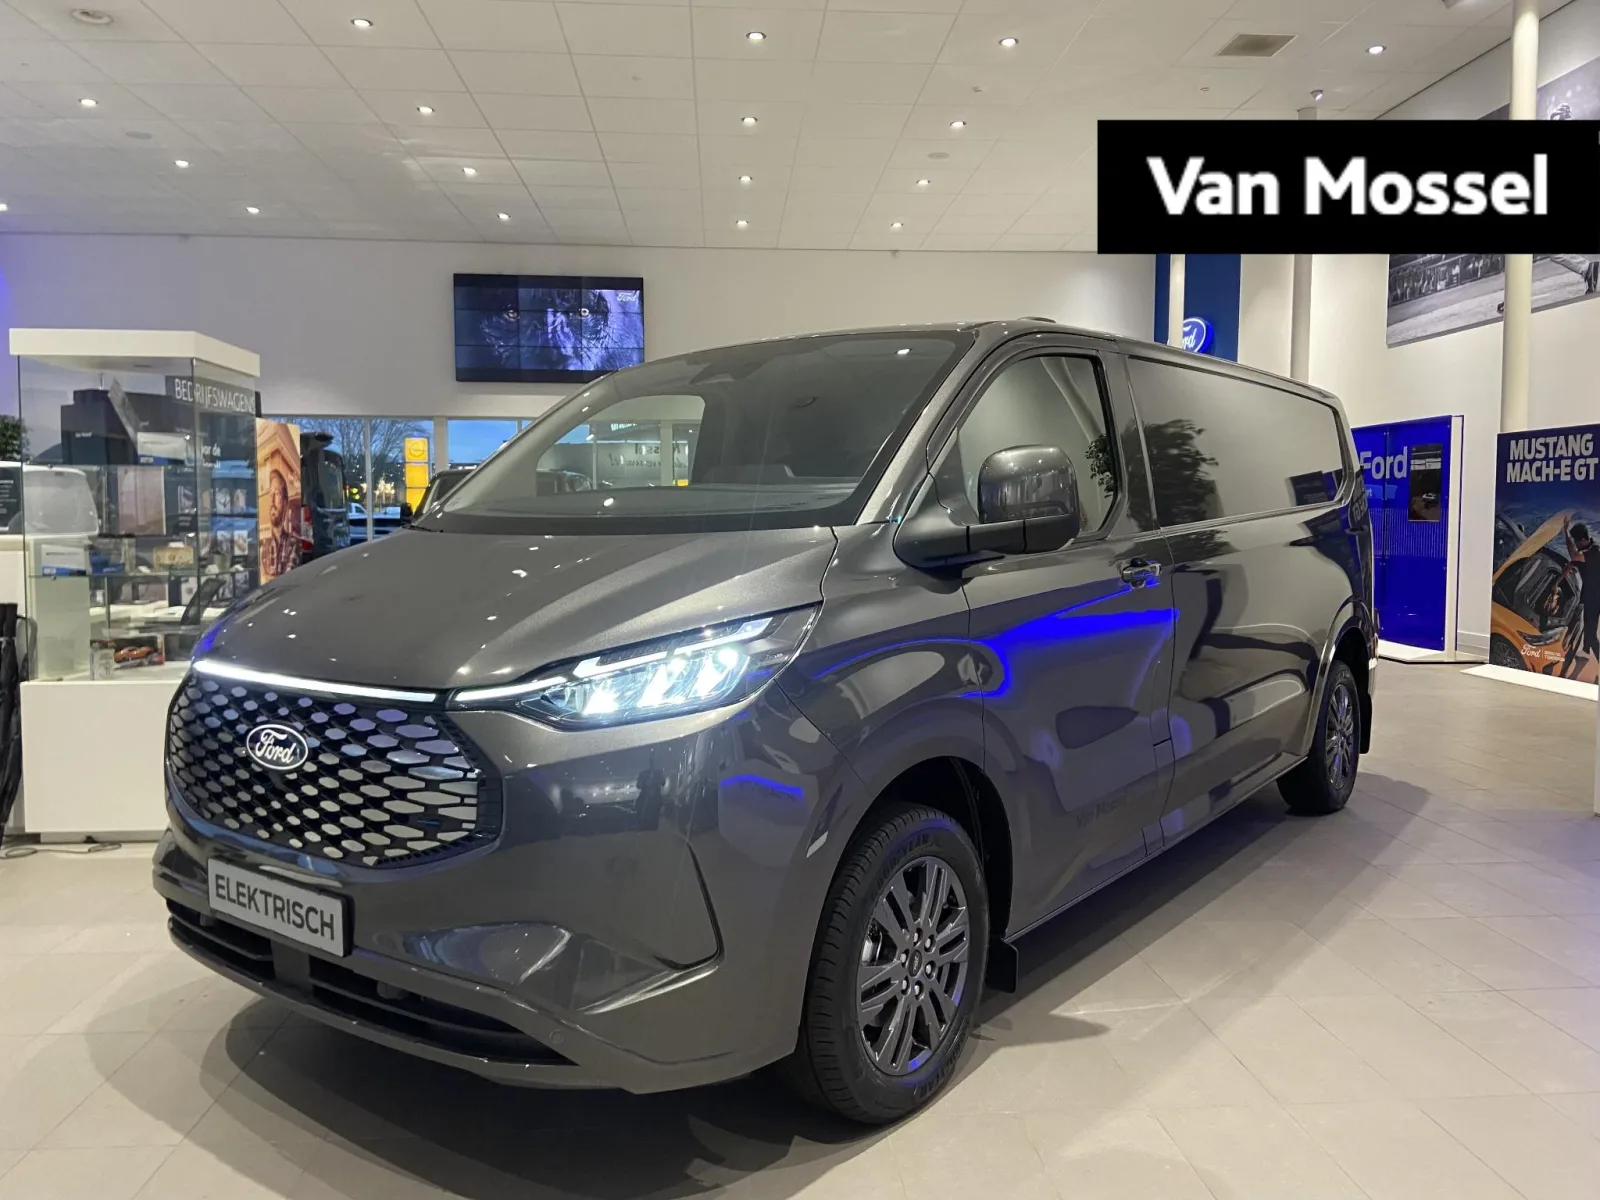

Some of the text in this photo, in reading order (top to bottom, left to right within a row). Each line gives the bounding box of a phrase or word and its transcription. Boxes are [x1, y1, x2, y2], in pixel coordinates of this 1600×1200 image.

[1509, 433, 1594, 460] MUSTANG
[1360, 446, 1408, 480] Ford
[1506, 457, 1599, 483] MACH-E GT
[1520, 643, 1541, 658] Ford
[255, 728, 297, 764] Ford
[214, 873, 335, 941] ELEKTRISCH
